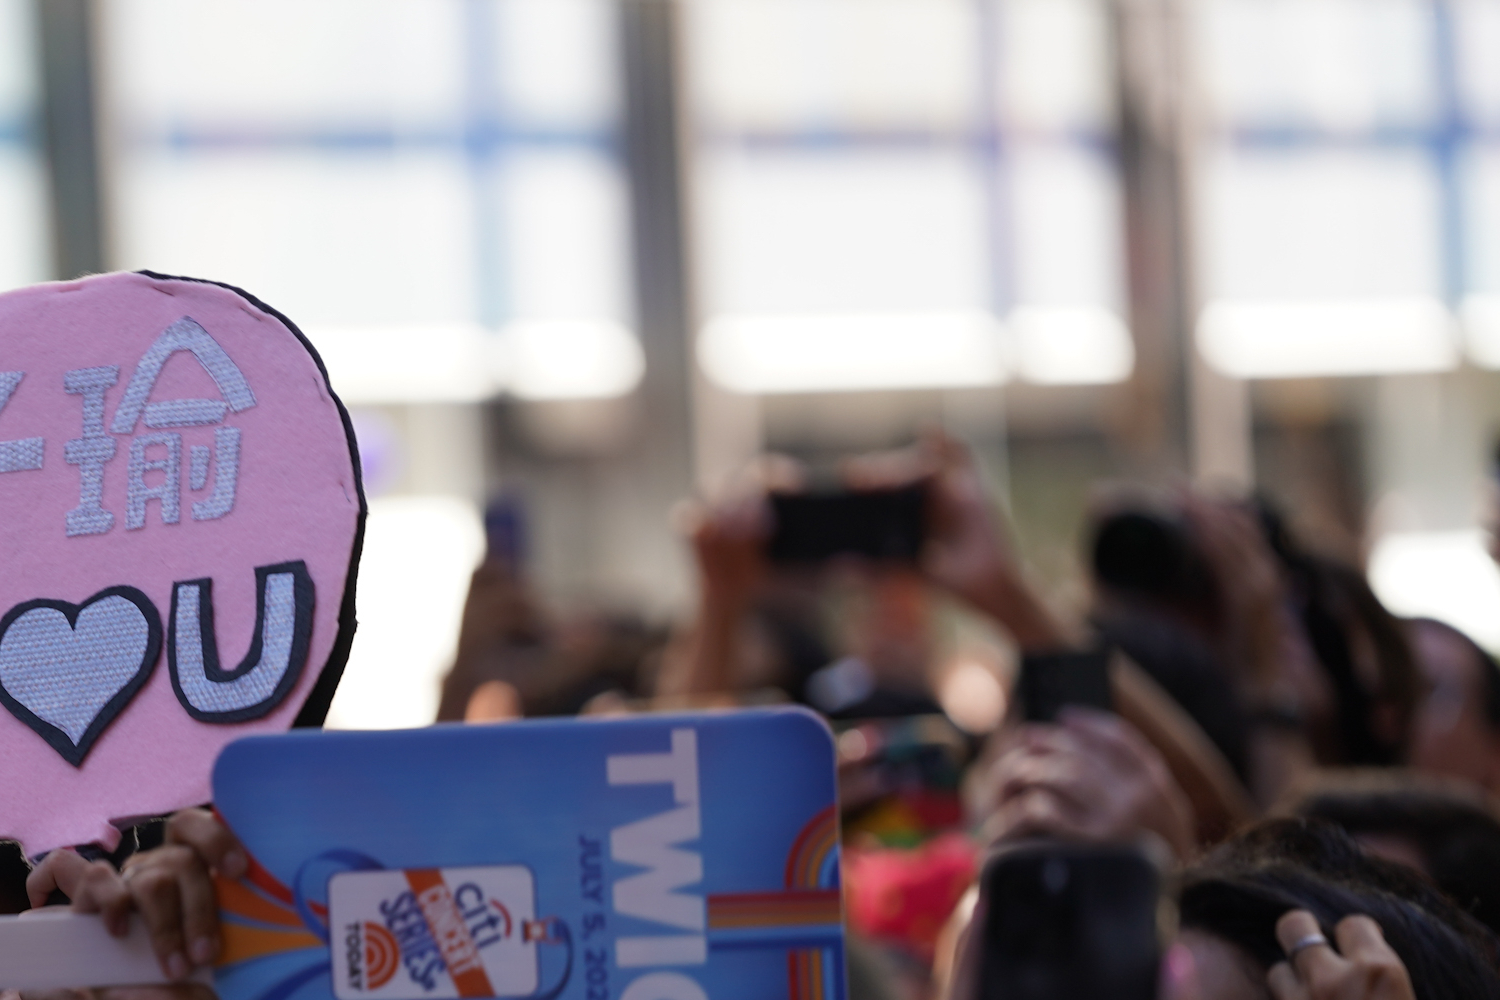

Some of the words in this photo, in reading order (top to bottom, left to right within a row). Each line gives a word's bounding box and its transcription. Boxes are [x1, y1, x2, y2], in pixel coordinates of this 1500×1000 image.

[167, 560, 315, 722] U
[579, 834, 604, 902] JULY
[345, 920, 363, 992] TODAY
[581, 914, 606, 942] 5,
